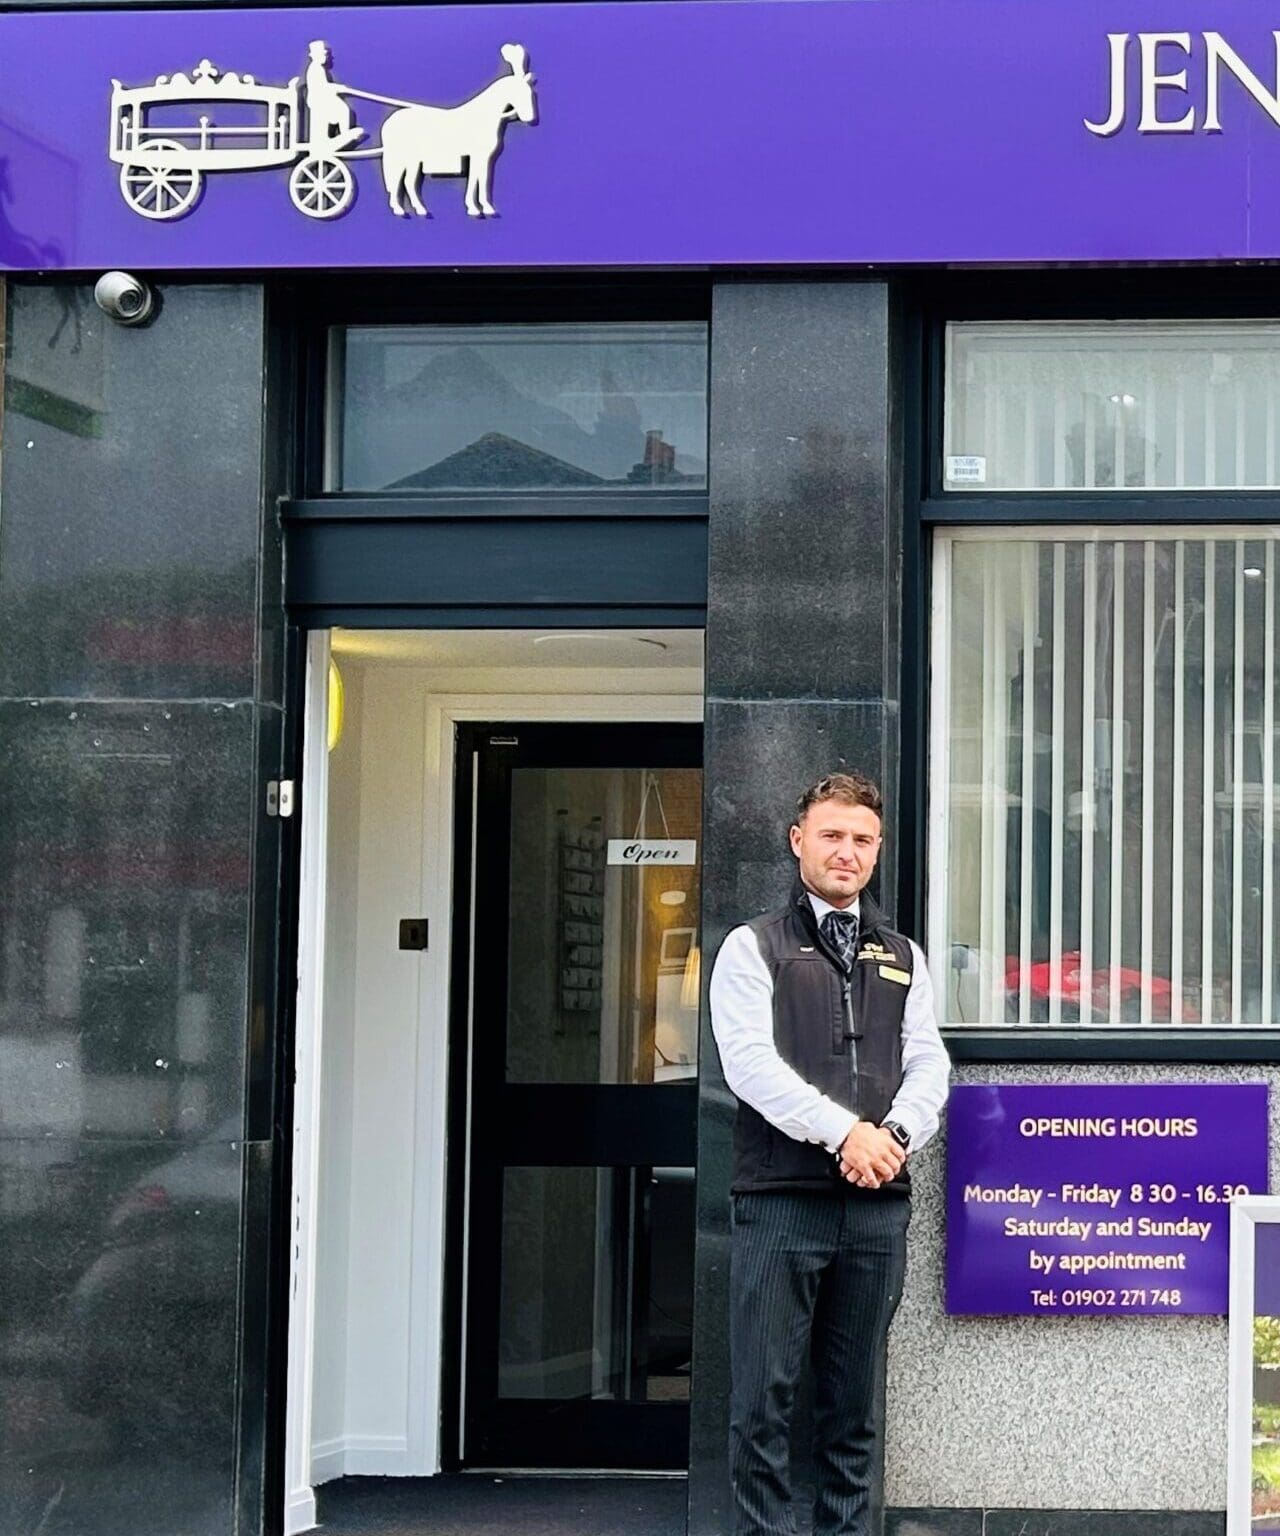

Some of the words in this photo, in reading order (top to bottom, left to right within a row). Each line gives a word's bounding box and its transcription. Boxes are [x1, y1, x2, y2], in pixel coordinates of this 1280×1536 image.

[622, 843, 679, 863] Open
[1019, 1118, 1116, 1137] OPENING
[1121, 1118, 1198, 1137] HOURS
[963, 1183, 1043, 1208] Monday
[1062, 1183, 1122, 1208] Friday
[1004, 1216, 1093, 1241] Saturday
[1095, 1216, 1134, 1237] and
[1137, 1216, 1212, 1241] Sunday
[1029, 1249, 1056, 1274] by
[1058, 1250, 1186, 1274] appointment
[1030, 1289, 1057, 1306] Tel:
[1061, 1289, 1116, 1306] 01902
[1120, 1289, 1147, 1306] 271
[1150, 1288, 1182, 1307] 748
